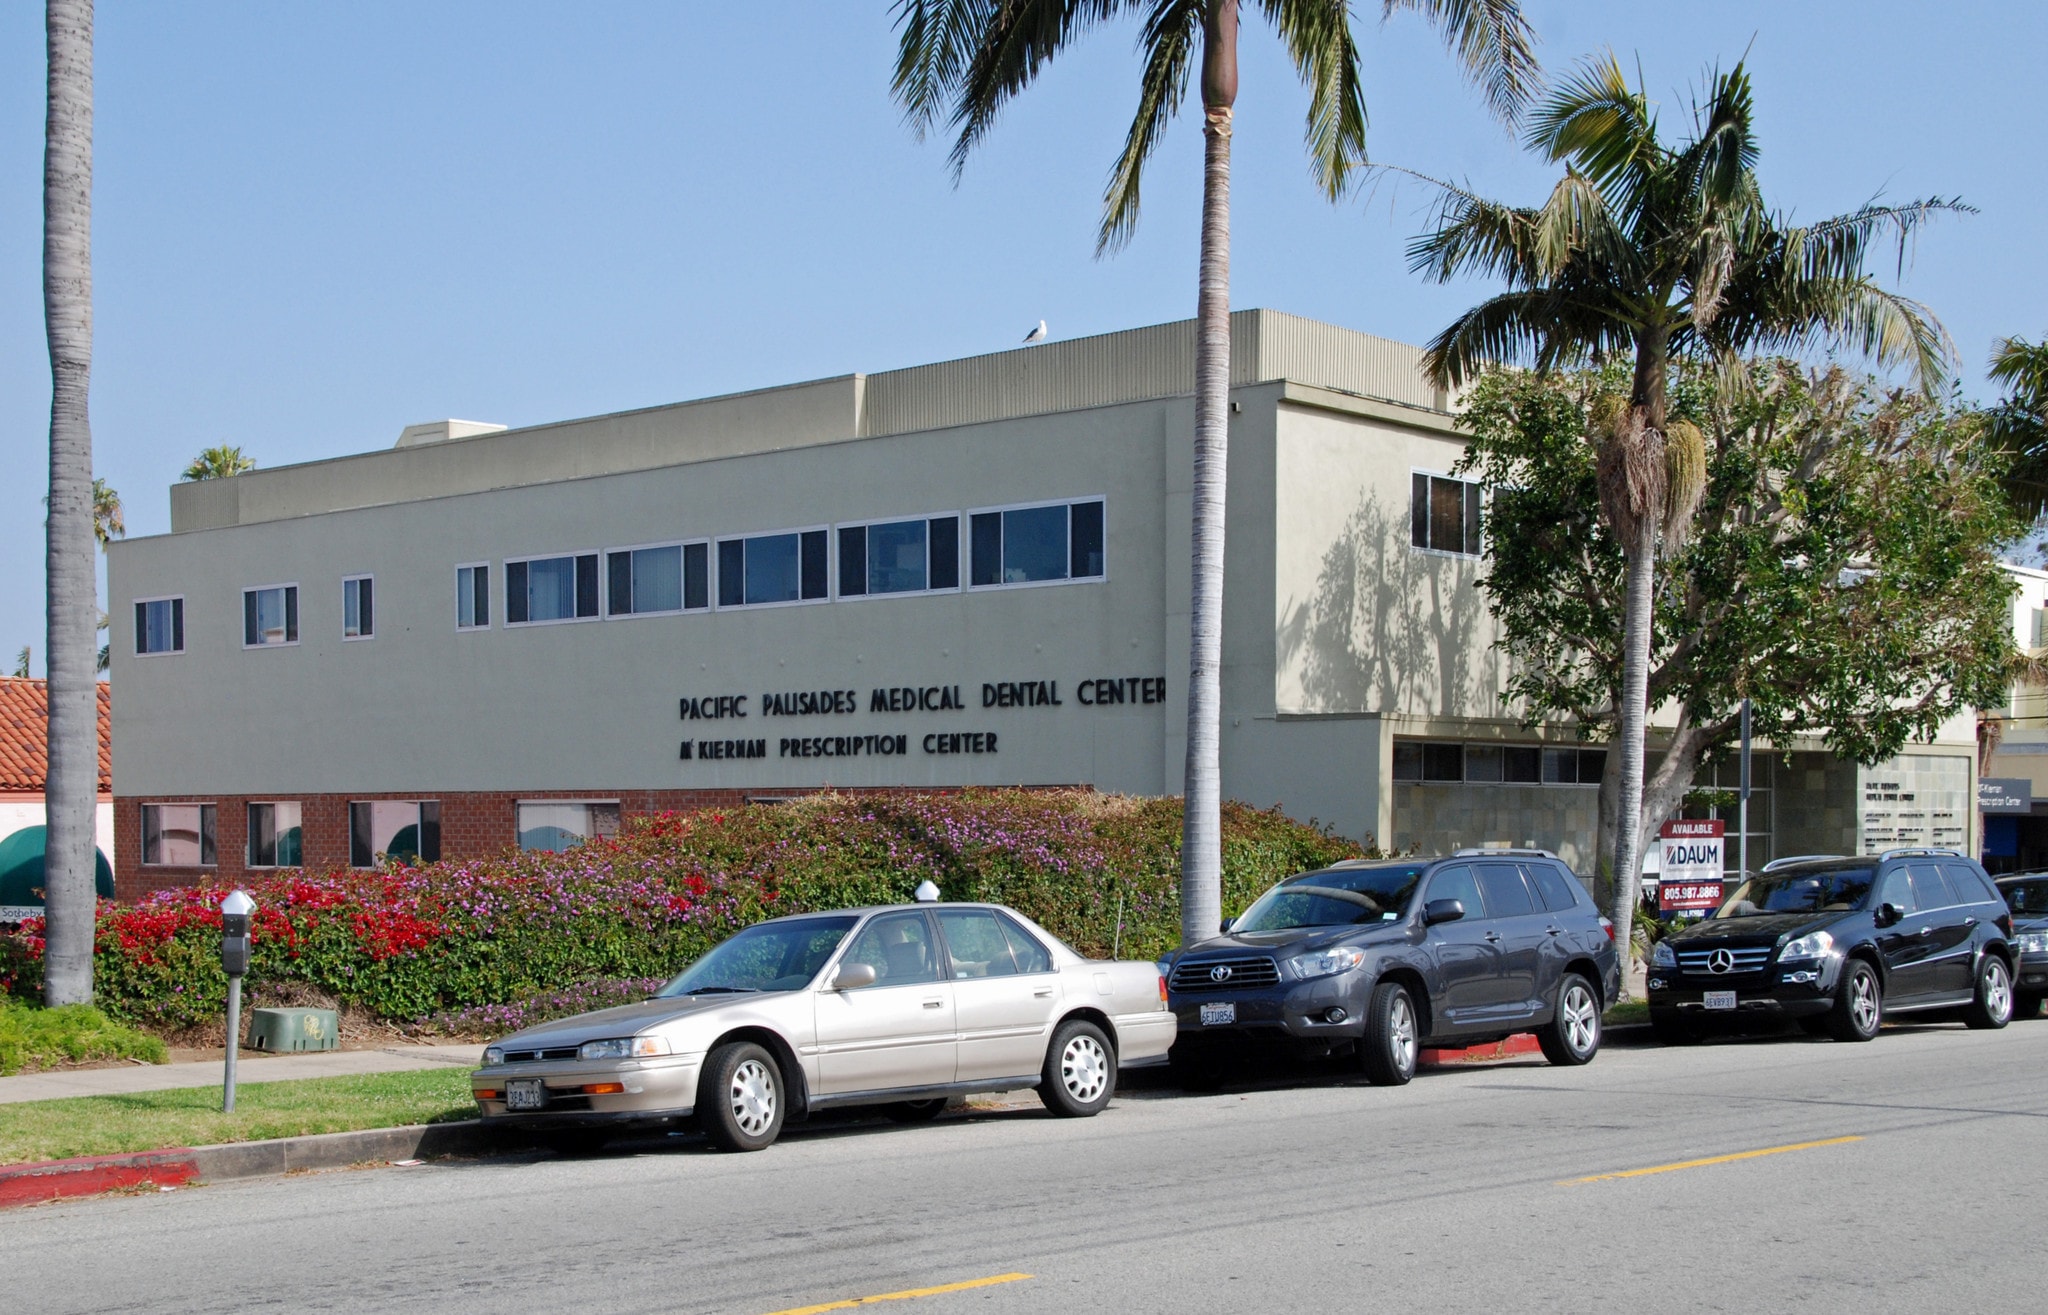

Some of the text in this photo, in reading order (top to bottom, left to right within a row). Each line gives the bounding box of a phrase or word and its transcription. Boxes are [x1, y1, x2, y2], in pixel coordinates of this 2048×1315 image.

[680, 677, 1166, 720] PACIFIC PALISADES MEDICAL DENTAL CENTER
[780, 734, 907, 758] PRESCRIPTION
[922, 732, 998, 754] CENTER
[1672, 824, 1713, 834] AVAILABLE
[1677, 845, 1718, 865] DAUM
